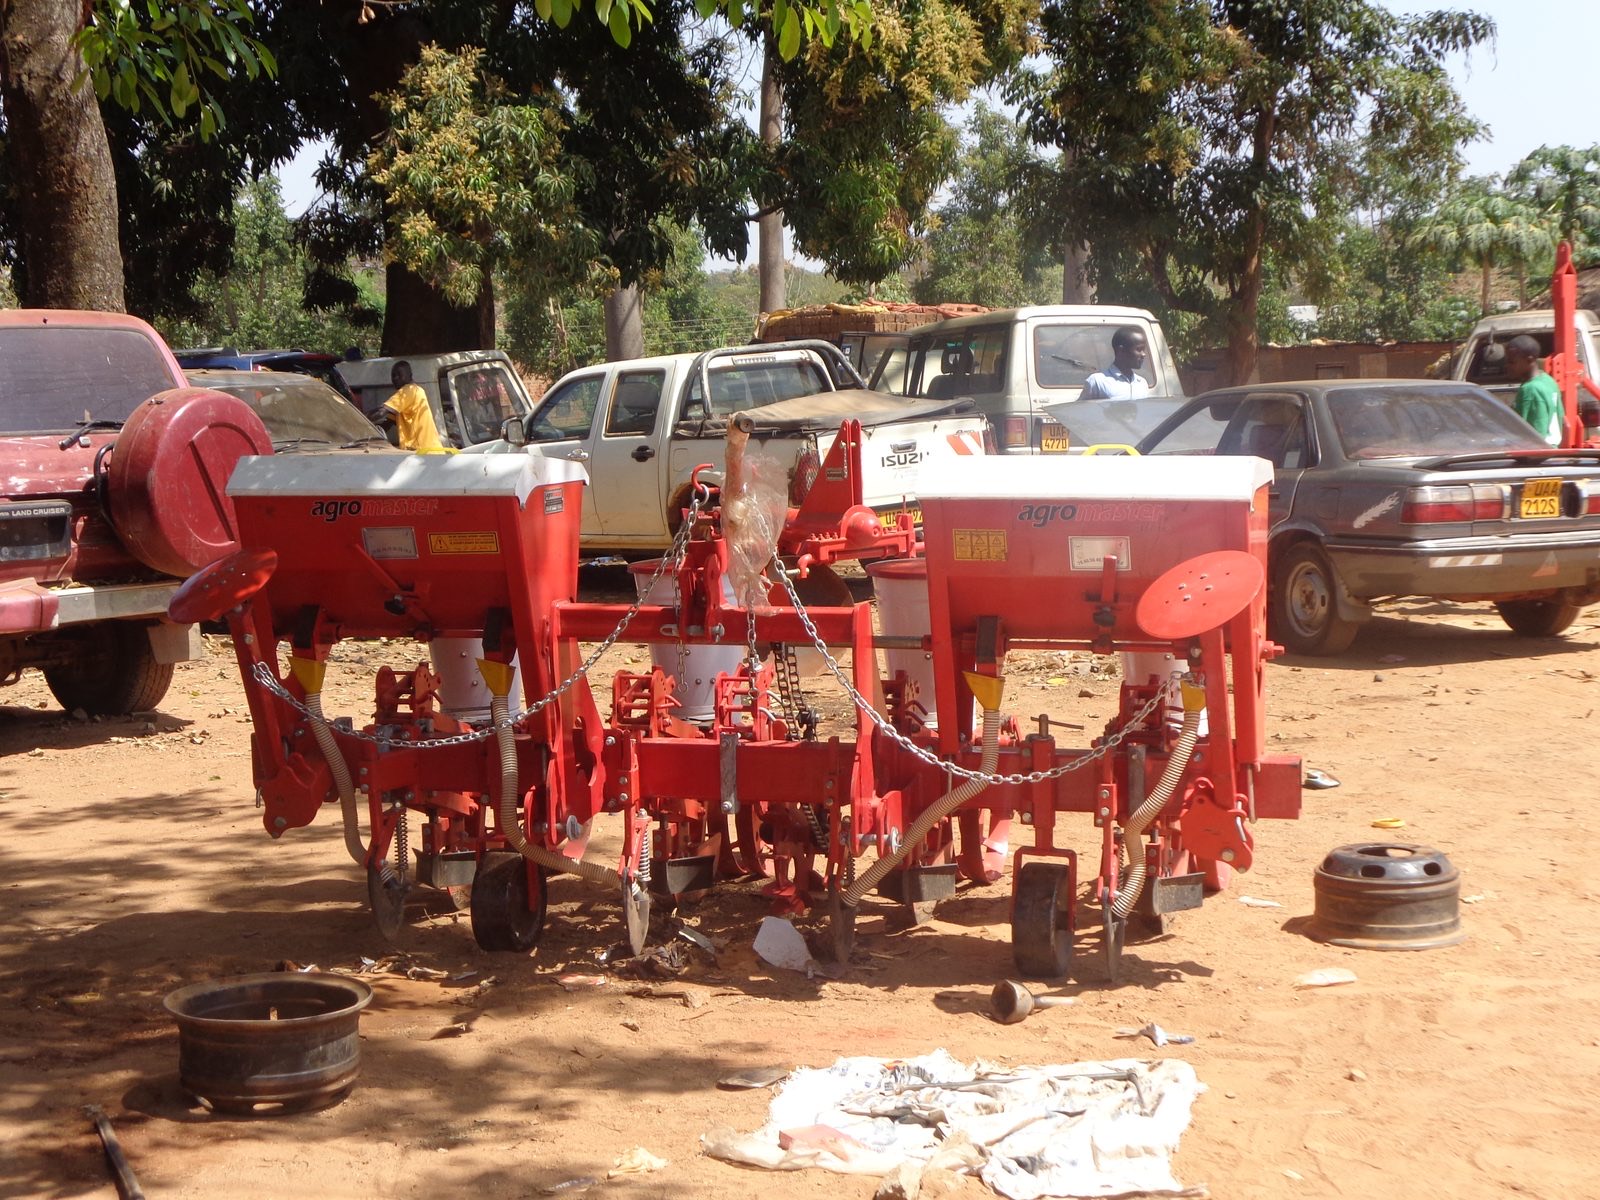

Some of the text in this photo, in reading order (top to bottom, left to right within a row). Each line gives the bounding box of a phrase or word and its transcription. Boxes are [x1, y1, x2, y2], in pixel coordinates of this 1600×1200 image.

[1049, 425, 1067, 437] UAF
[1535, 480, 1560, 497] UAA
[11, 509, 32, 517] LAND
[32, 507, 66, 515] CRUISER
[311, 497, 438, 522] agromaster
[1018, 502, 1164, 528] agromaster
[1525, 498, 1556, 515] 212S
